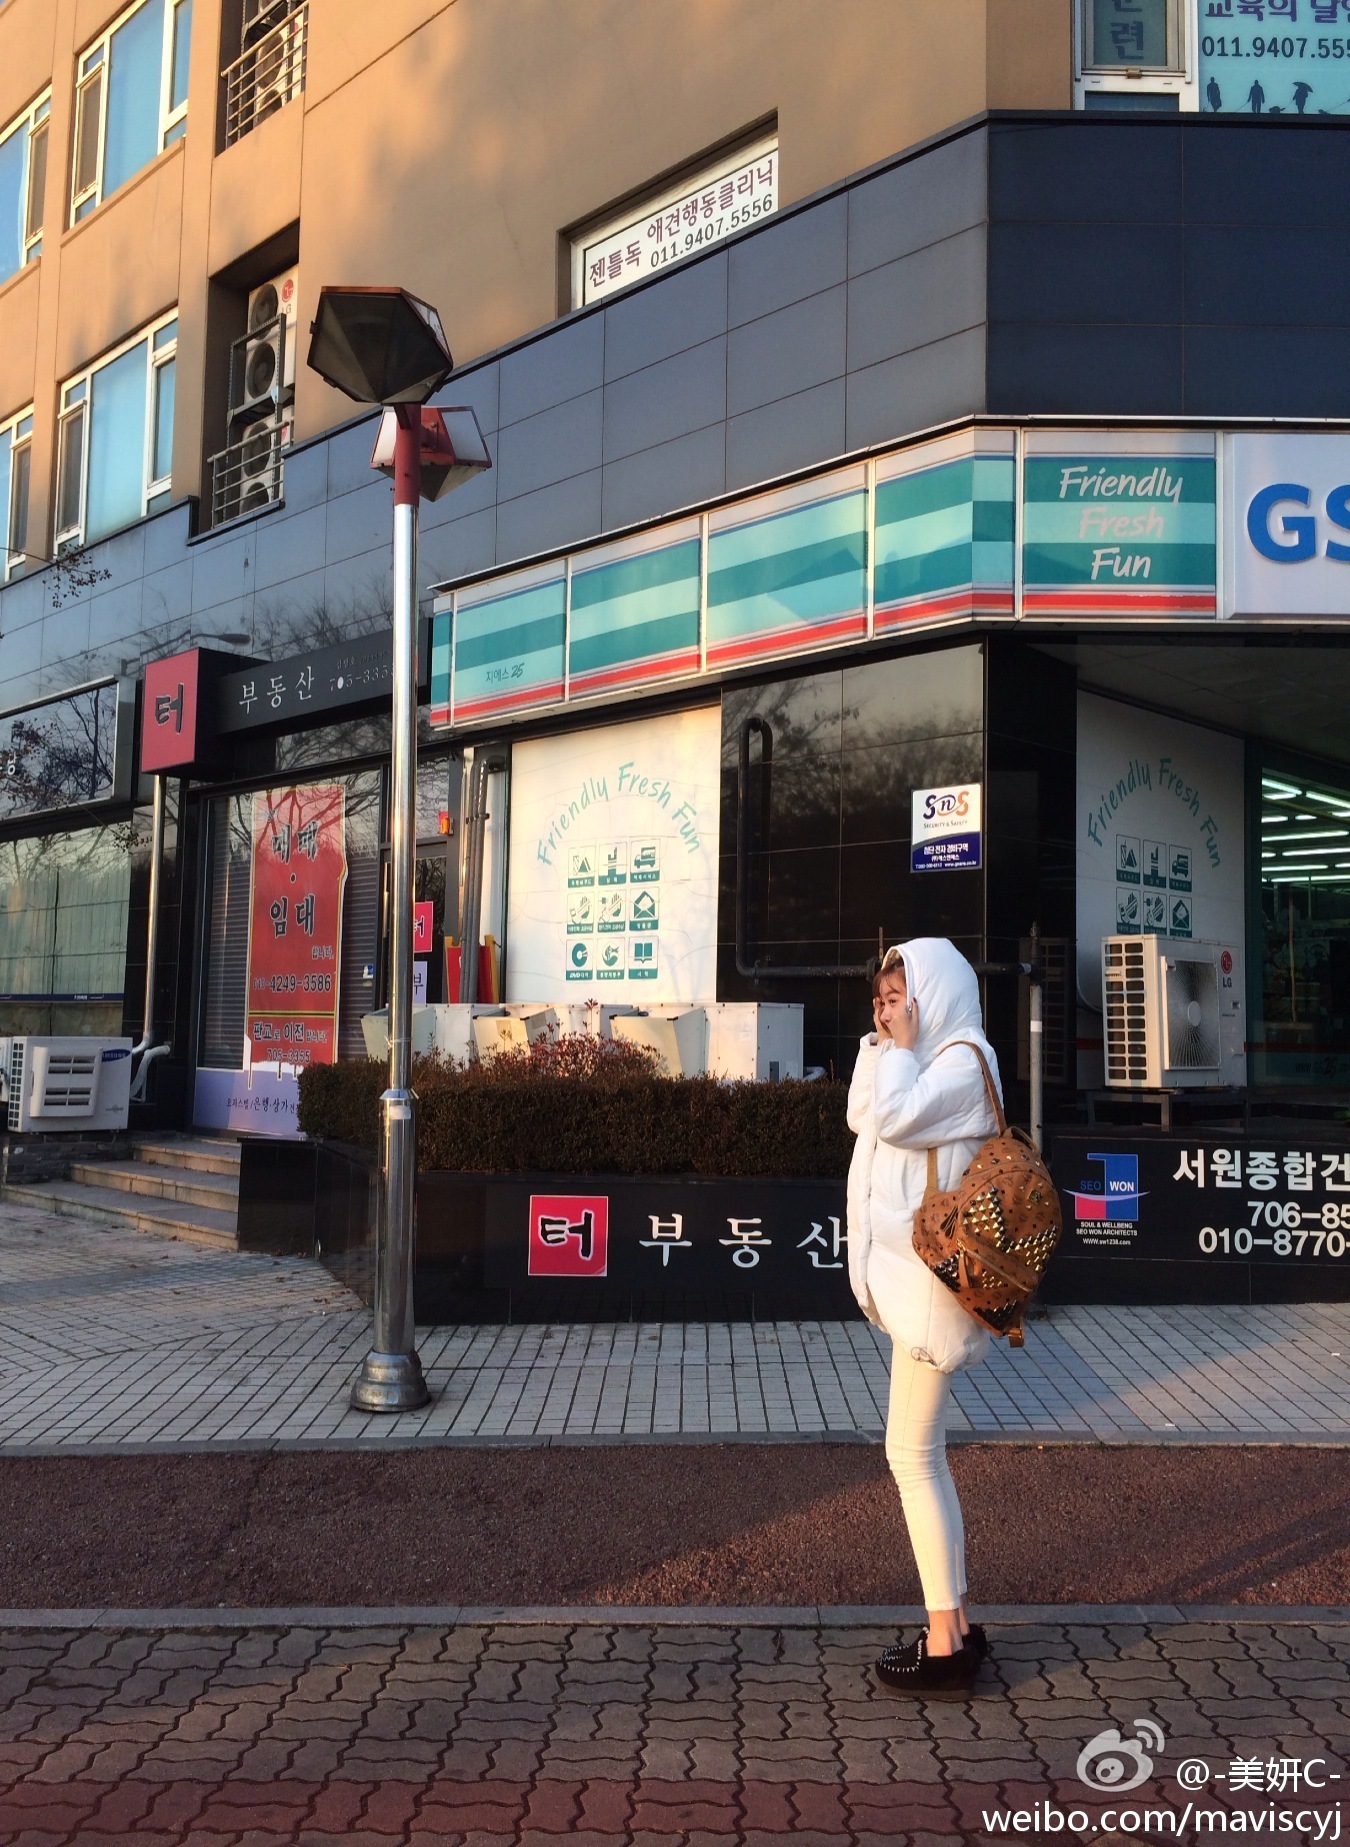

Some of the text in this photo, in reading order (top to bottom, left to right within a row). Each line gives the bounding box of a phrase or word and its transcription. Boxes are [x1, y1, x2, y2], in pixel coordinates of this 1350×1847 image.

[1201, 36, 1350, 59] 011.9407.55
[589, 157, 774, 288] 젠틀독 애견행동클리닉
[650, 192, 773, 268] 011.9407.5556
[1058, 465, 1184, 506] Friendly
[1078, 506, 1165, 539] Fresh
[1090, 546, 1151, 581] Fun
[155, 681, 185, 736] 터
[238, 665, 316, 716] 부동산
[536, 761, 701, 867] Friendly Fresh Fun
[1087, 756, 1221, 870] Friendly Fresh Fun
[270, 893, 316, 939] 임대
[1222, 976, 1233, 989] LG
[1080, 1181, 1135, 1192] SEO WON
[538, 1208, 848, 1268] 터 부동산
[1102, 1228, 1138, 1236] ARCHITECTS
